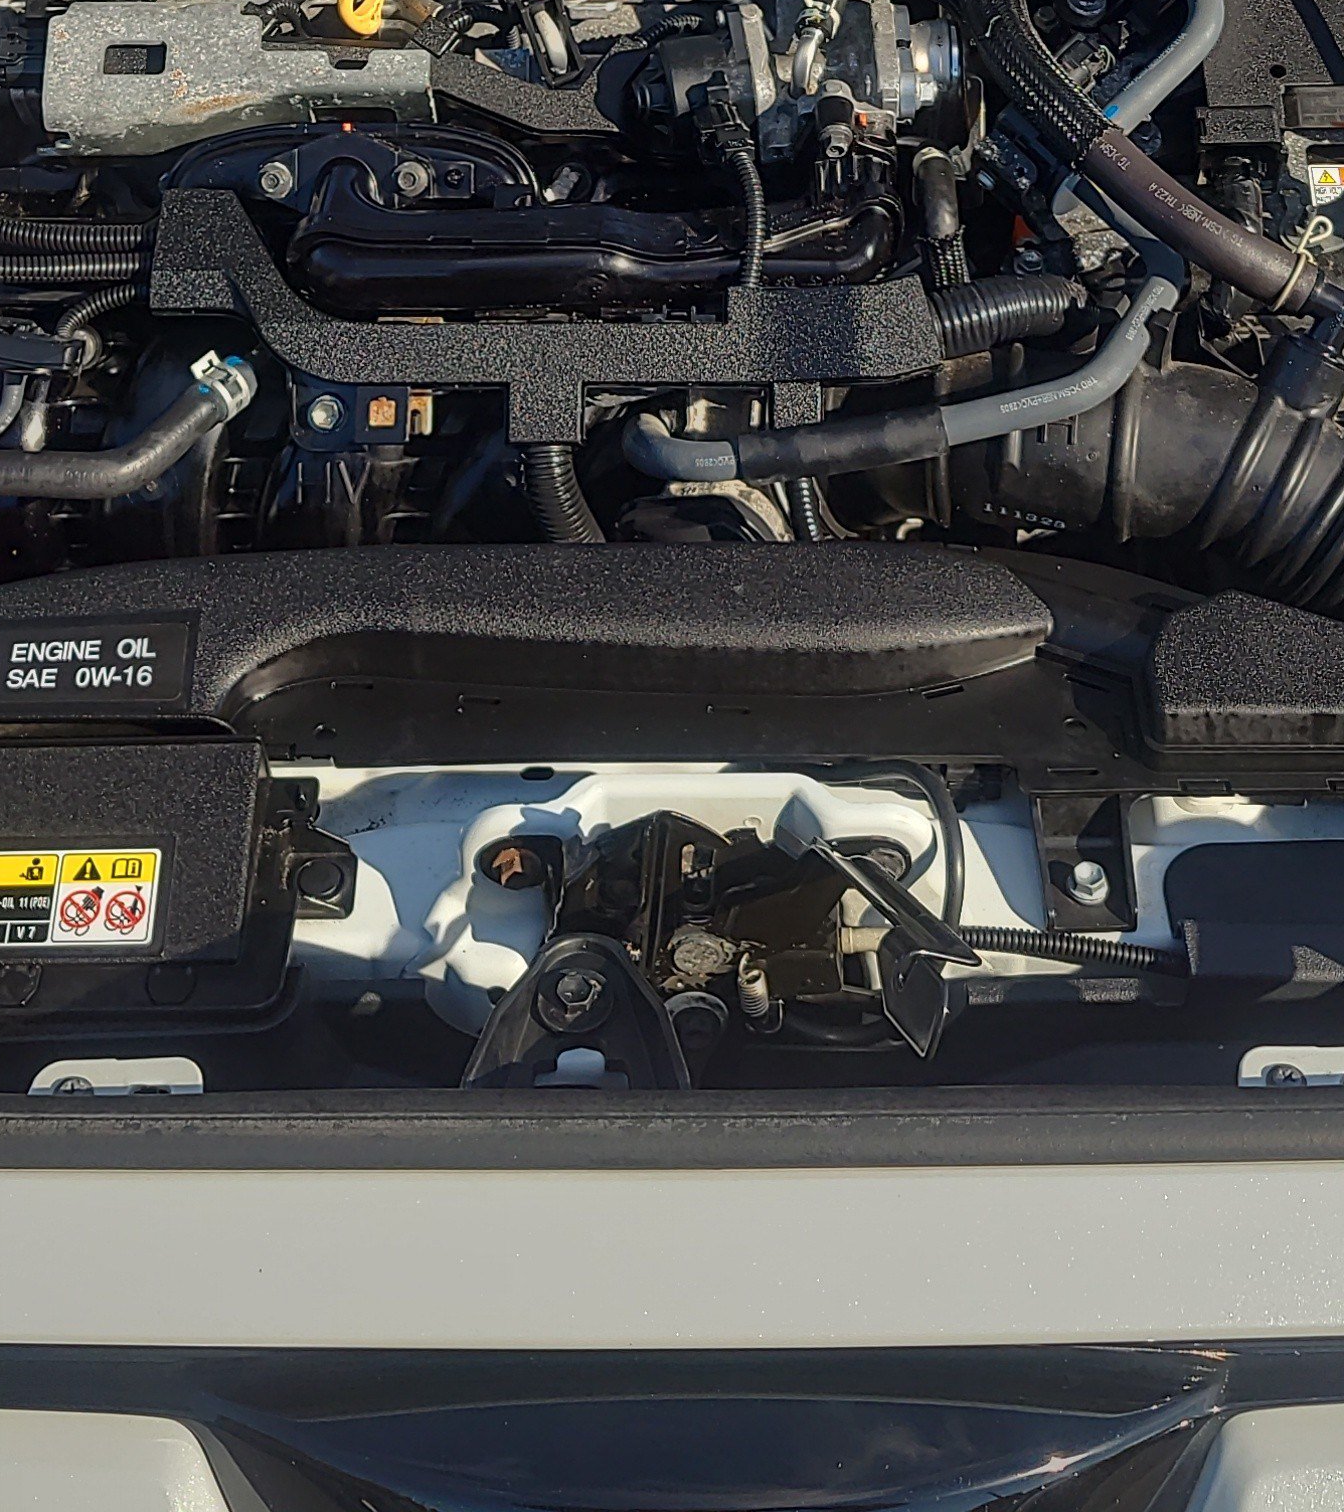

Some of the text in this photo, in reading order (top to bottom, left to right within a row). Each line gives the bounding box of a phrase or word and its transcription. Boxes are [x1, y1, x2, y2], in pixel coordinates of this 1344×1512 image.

[11, 637, 156, 662] ENGINE OIL
[6, 665, 153, 689] SAE 0W-16
[17, 925, 36, 940] V 7
